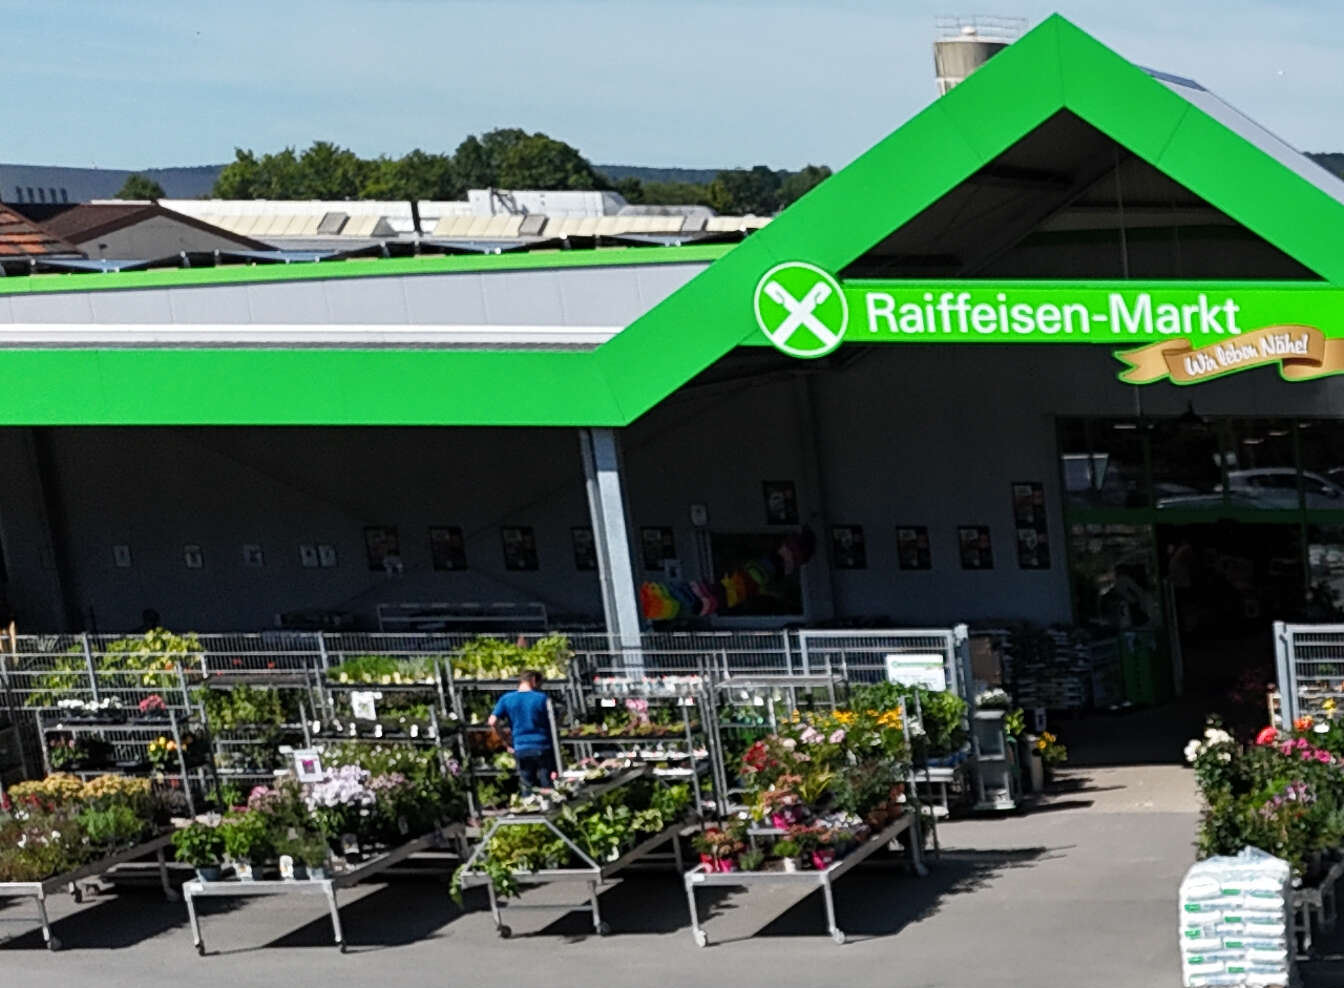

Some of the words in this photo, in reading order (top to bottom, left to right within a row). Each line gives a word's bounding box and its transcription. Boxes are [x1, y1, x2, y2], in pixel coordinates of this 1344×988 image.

[867, 291, 1241, 335] Raiffeisen-Markt
[1184, 350, 1217, 377] Wir
[1215, 343, 1259, 369] leben
[1259, 333, 1309, 358] Nähe!
